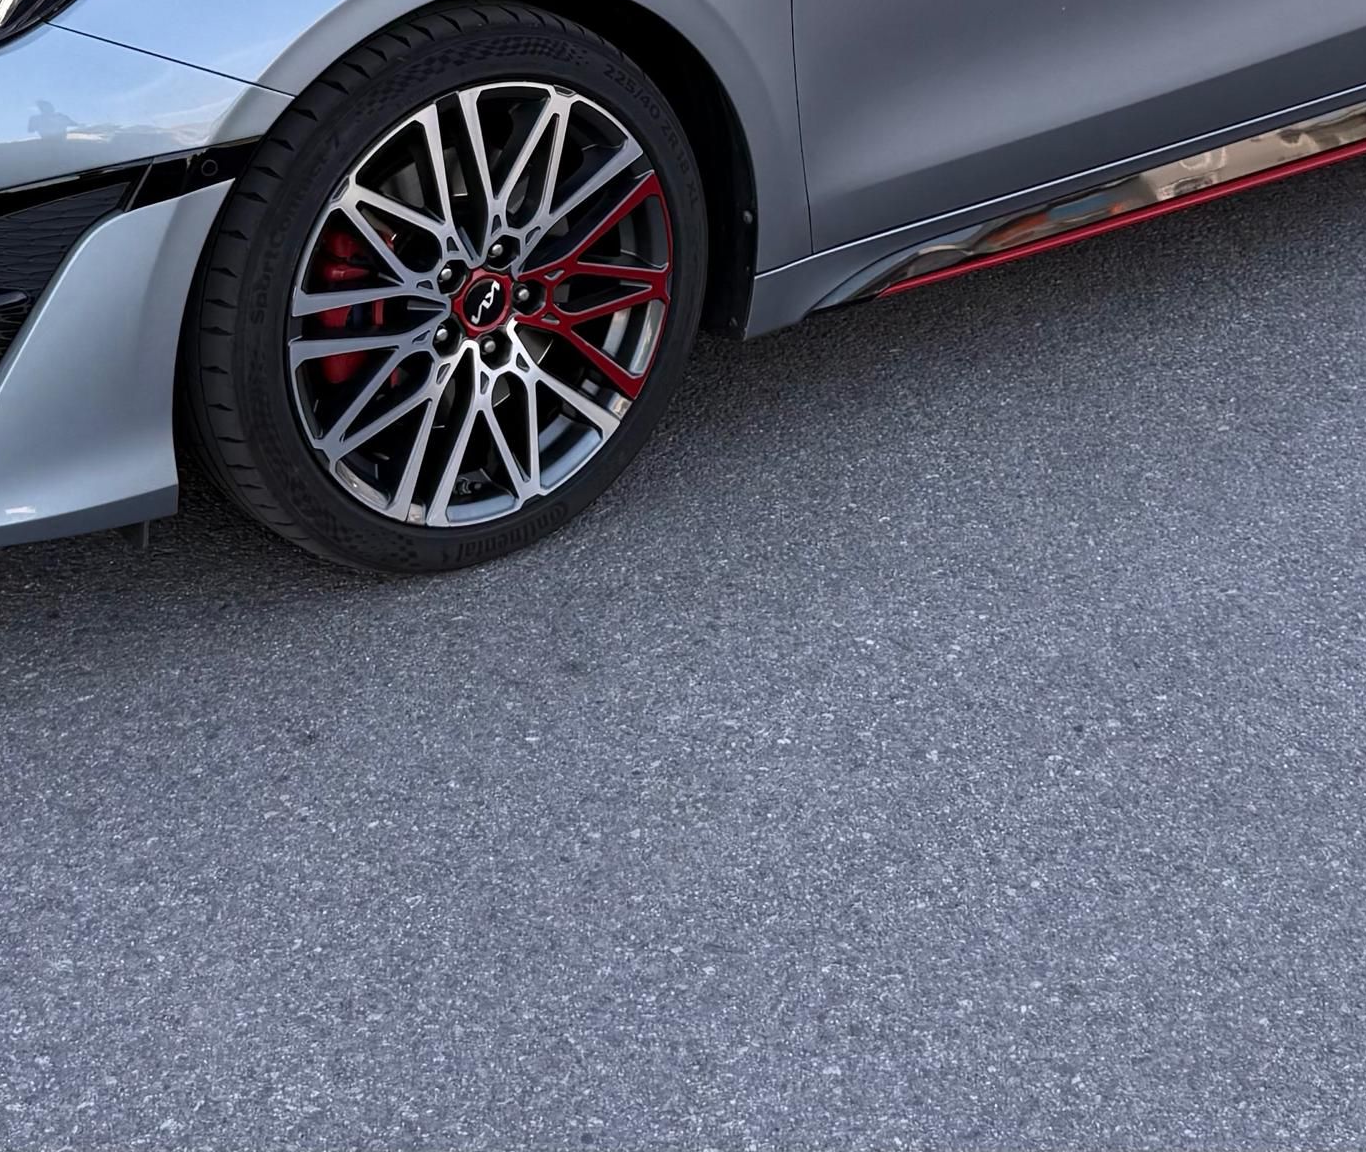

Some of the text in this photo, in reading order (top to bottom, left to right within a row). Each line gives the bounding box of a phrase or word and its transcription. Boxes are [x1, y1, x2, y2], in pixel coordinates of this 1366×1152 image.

[601, 62, 663, 122] 225/40
[659, 120, 681, 150] ZR
[685, 181, 699, 207] XL
[471, 280, 501, 325] KIA
[456, 501, 572, 563] Continental
